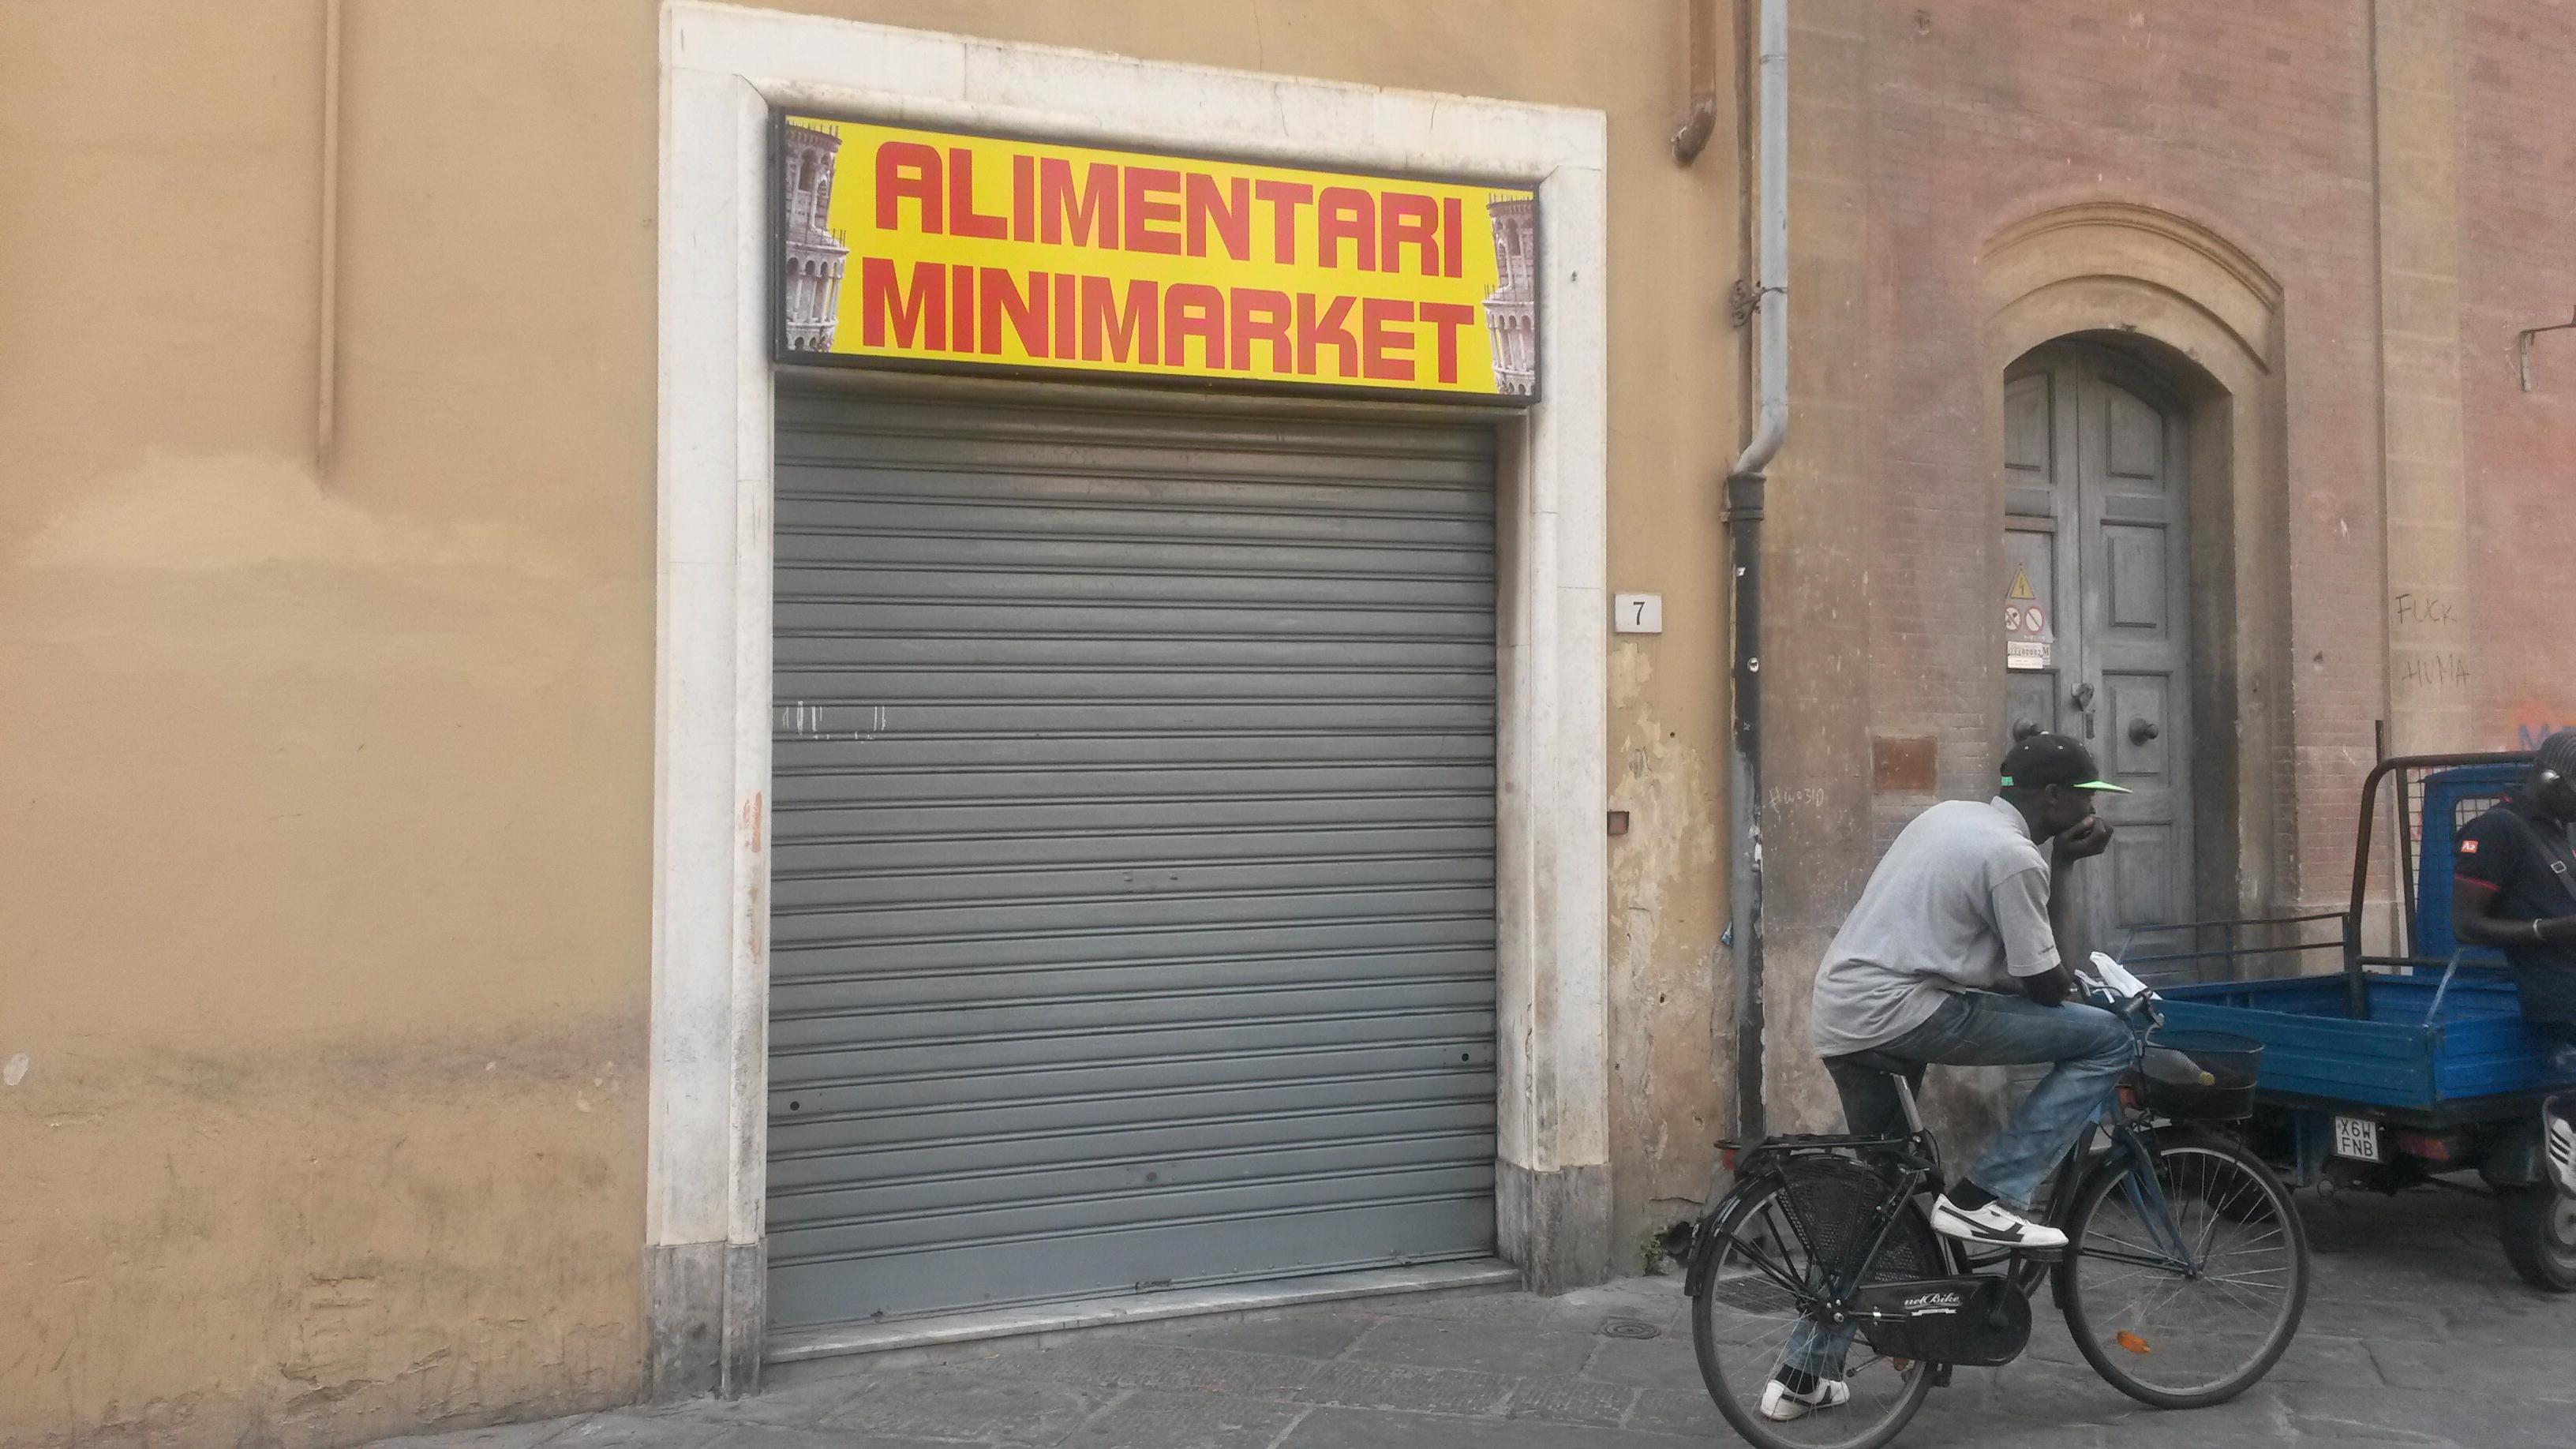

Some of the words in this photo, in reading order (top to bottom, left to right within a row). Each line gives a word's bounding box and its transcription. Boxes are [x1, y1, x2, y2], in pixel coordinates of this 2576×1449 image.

[875, 140, 1463, 279] ALIMENTARI
[861, 257, 1475, 384] MINIMARKET
[1632, 601, 1646, 626] 7
[2394, 593, 2457, 625] FUCK
[2339, 1118, 2372, 1140] X6W
[2341, 1136, 2374, 1157] FNB
